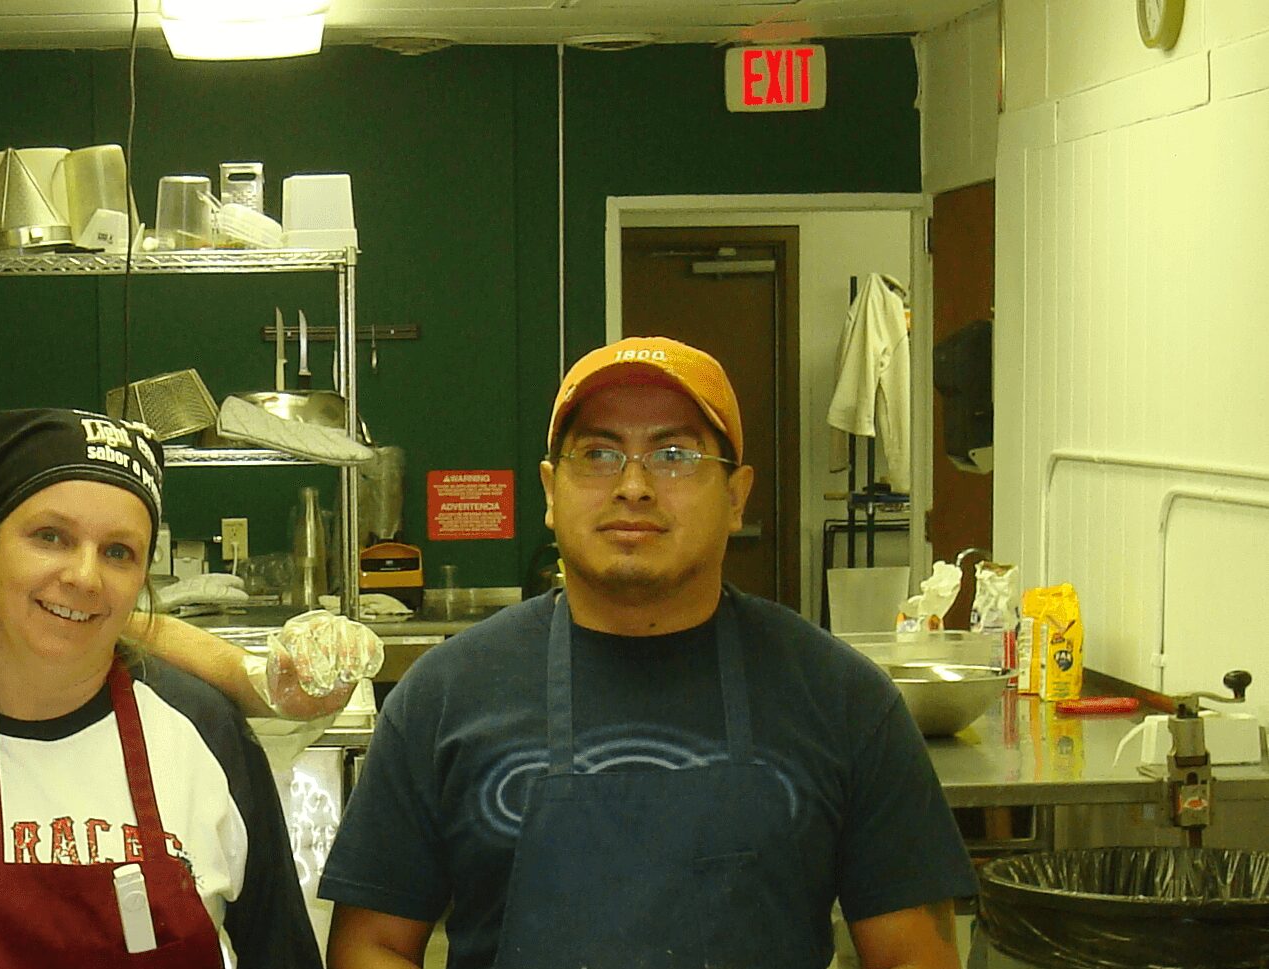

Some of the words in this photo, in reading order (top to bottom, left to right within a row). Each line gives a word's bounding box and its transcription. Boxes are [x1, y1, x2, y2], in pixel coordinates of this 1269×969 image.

[742, 48, 814, 106] EXIT
[615, 349, 666, 361] 1800
[87, 444, 130, 468] sabor
